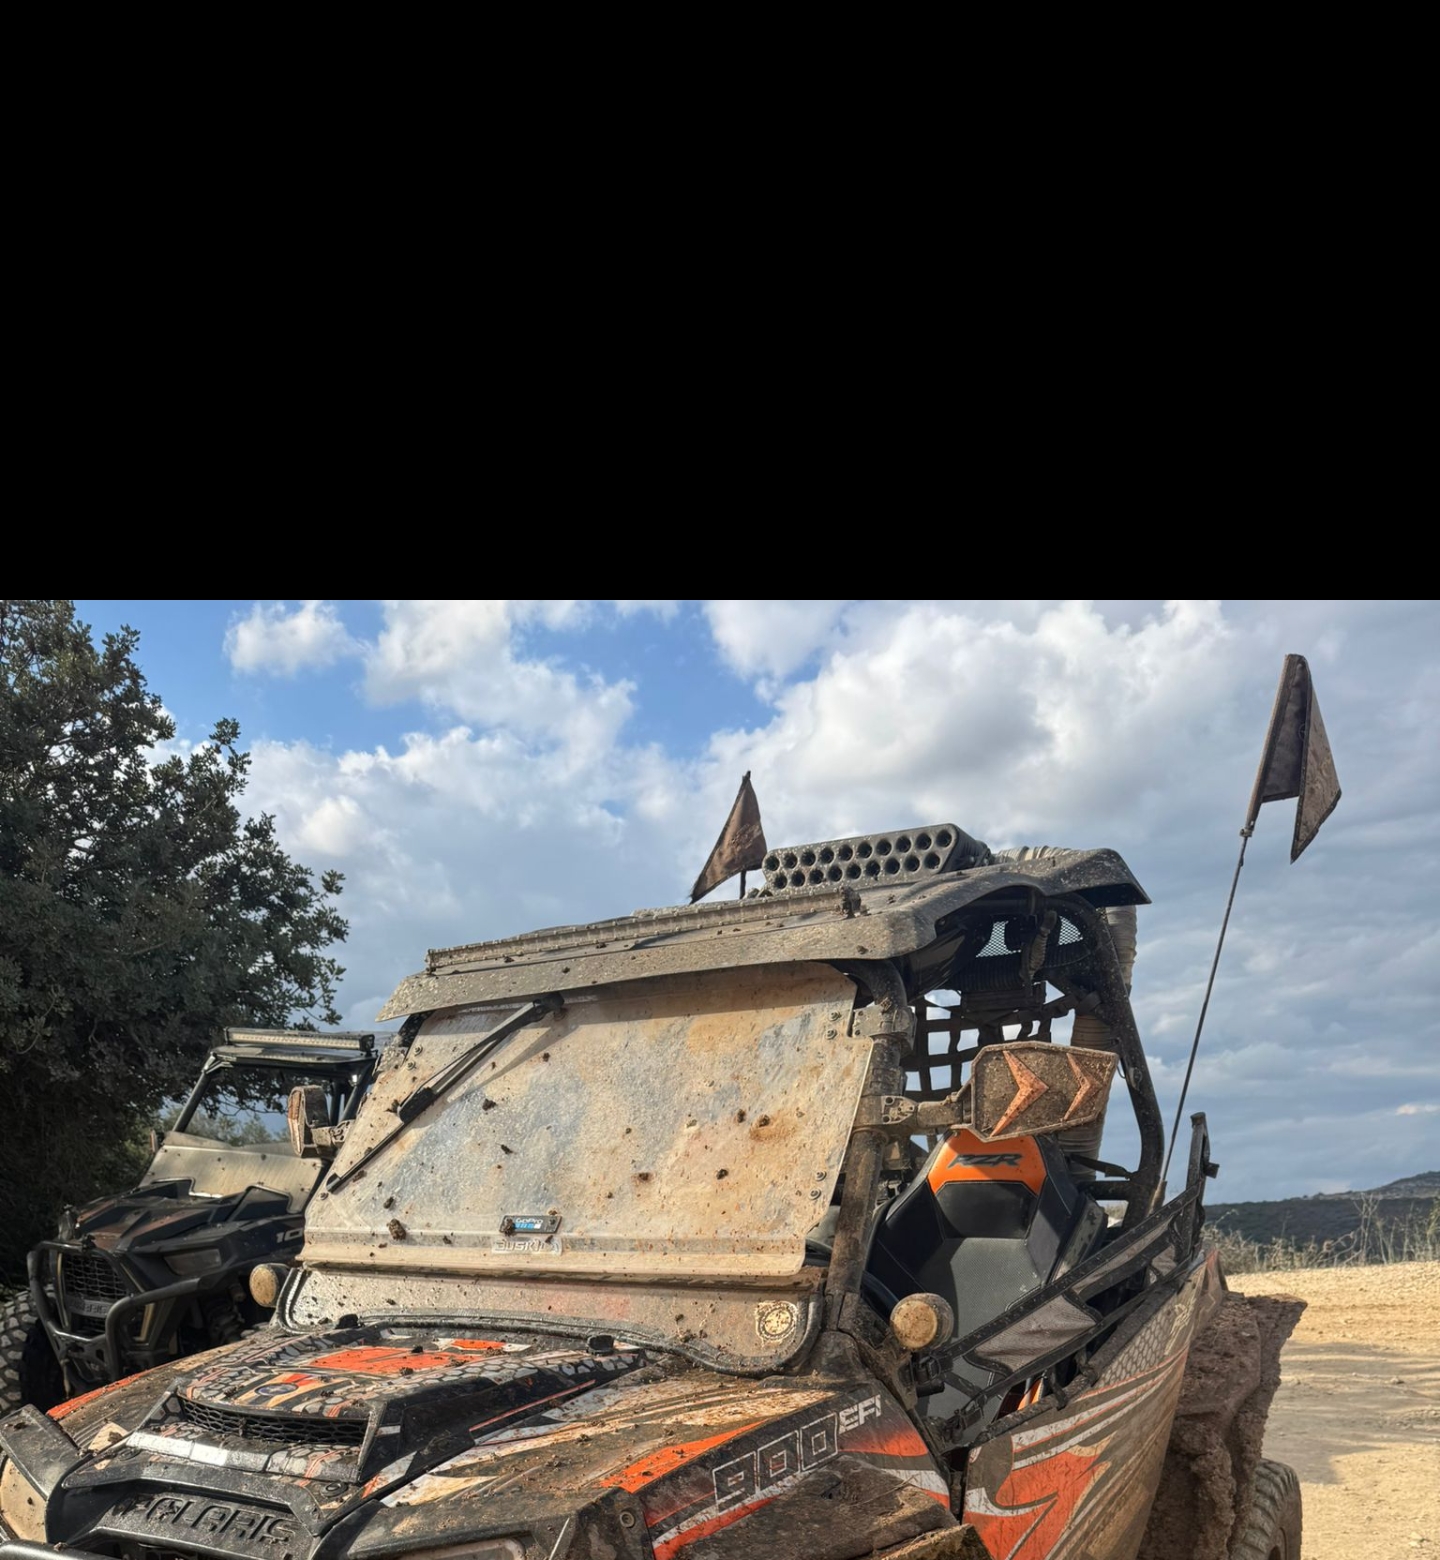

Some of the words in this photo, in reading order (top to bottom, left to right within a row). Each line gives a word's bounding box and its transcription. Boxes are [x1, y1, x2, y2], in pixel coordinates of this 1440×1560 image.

[946, 1153, 1023, 1169] RZR
[712, 1412, 839, 1515] 900
[838, 1394, 882, 1434] EFI
